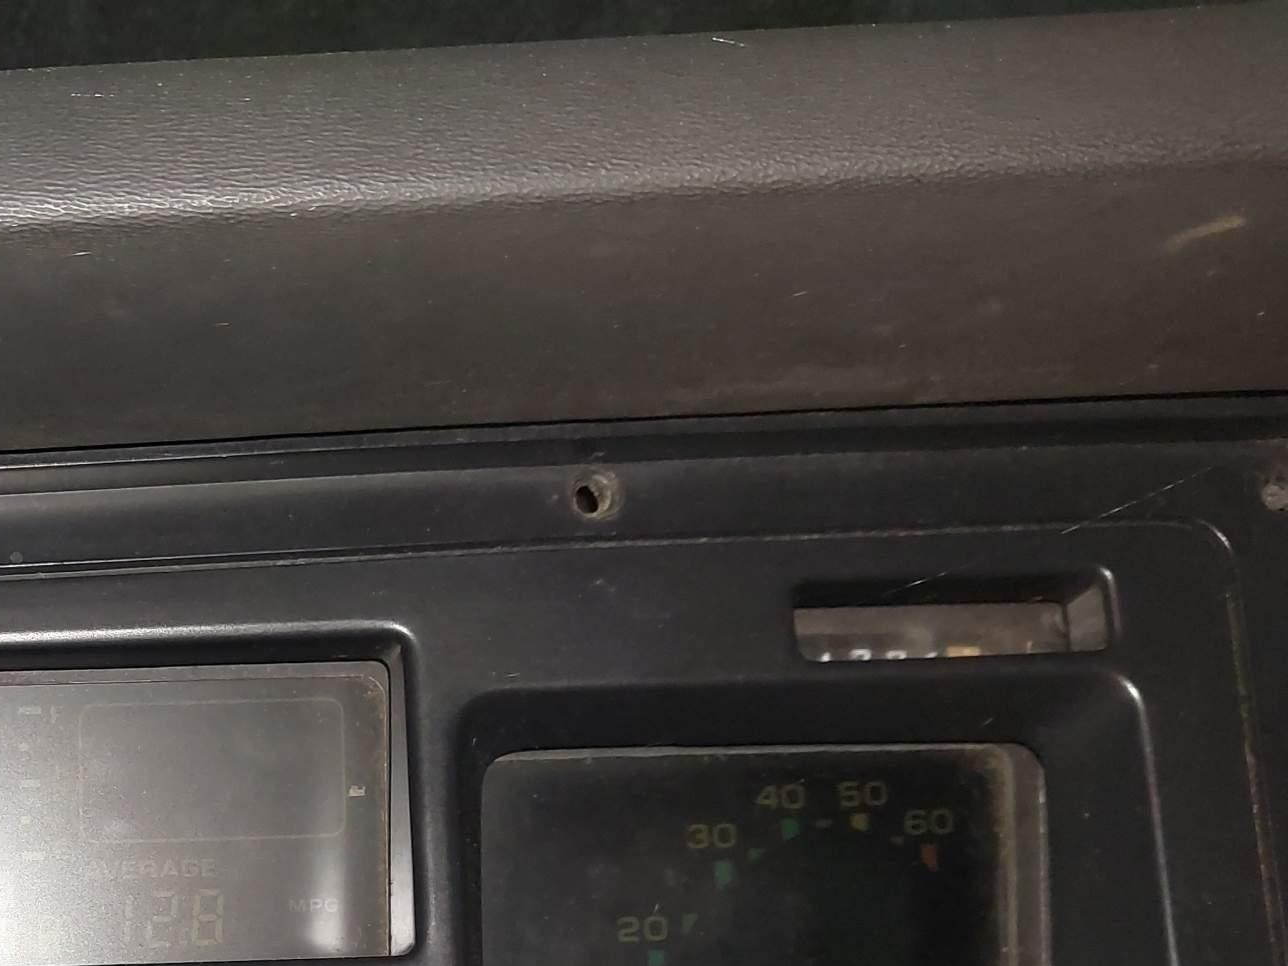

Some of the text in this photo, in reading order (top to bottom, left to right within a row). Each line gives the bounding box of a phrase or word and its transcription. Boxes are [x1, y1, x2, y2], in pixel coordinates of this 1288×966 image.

[754, 782, 806, 809] 40
[836, 781, 888, 807] 50
[903, 809, 955, 835] 60
[686, 824, 737, 849] 30
[287, 896, 339, 914] MPG
[616, 915, 668, 942] 20
